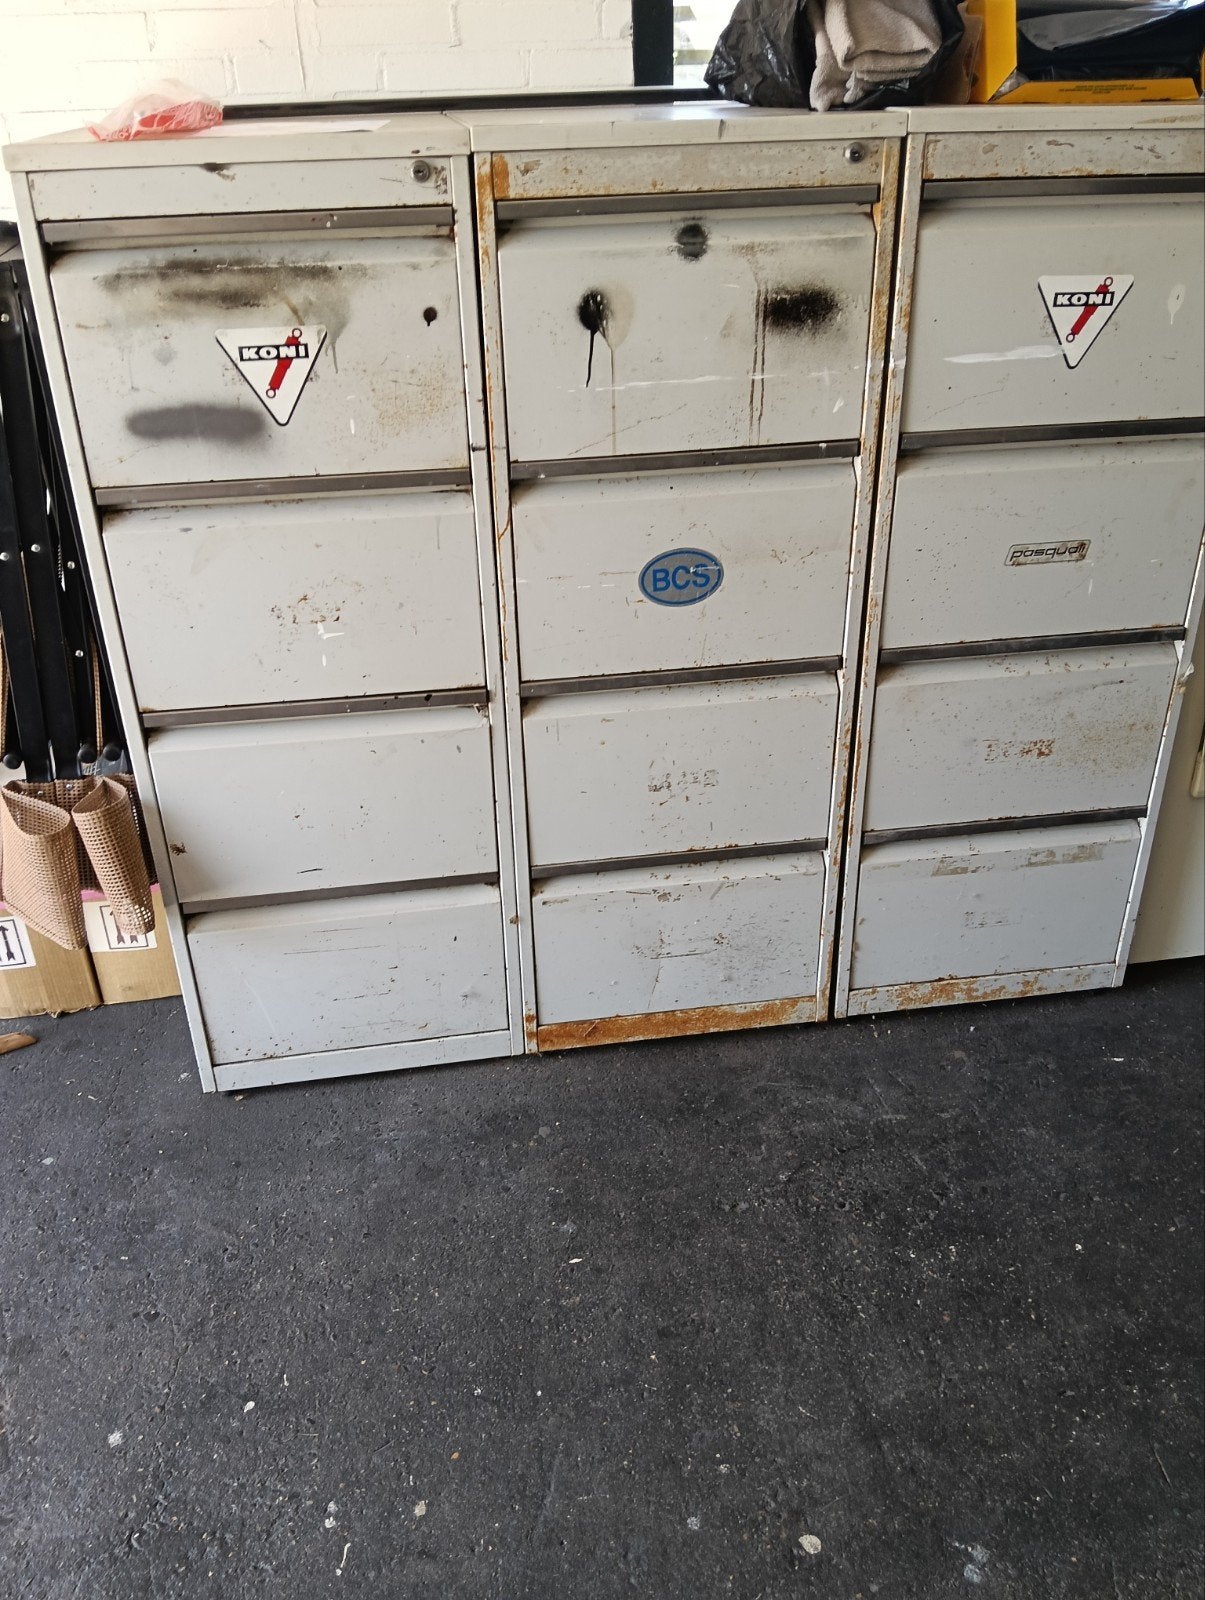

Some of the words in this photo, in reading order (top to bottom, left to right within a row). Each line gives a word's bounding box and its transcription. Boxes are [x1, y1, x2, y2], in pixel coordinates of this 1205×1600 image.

[1055, 293, 1112, 306] KONI
[241, 344, 307, 360] KONI
[652, 563, 711, 592] BCS
